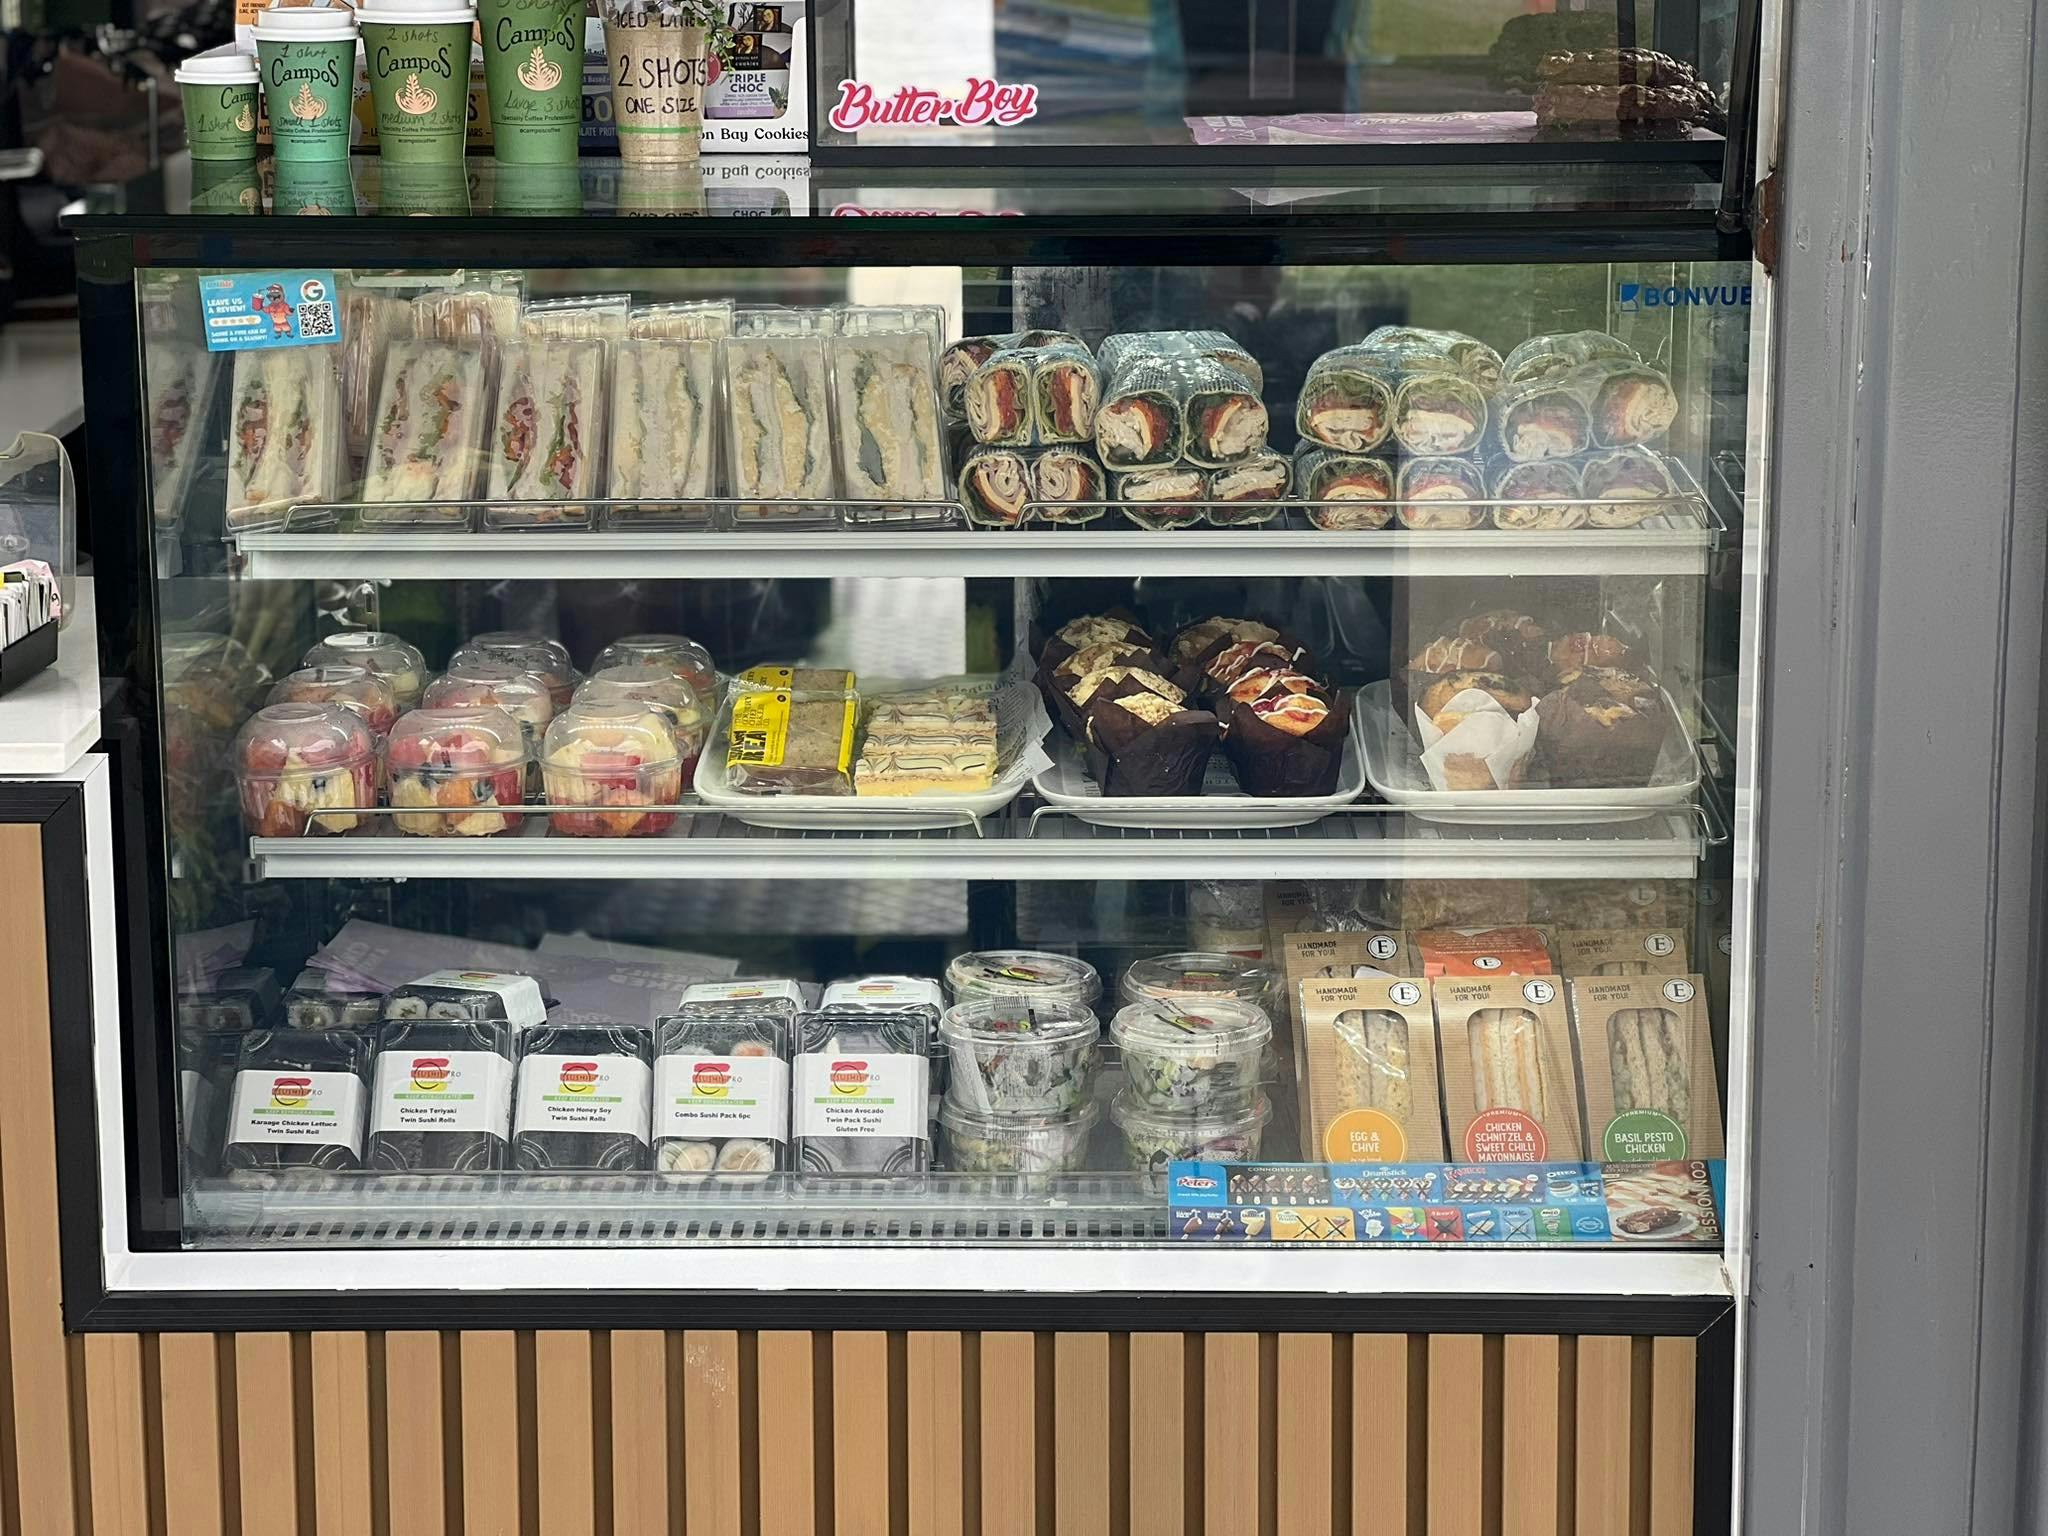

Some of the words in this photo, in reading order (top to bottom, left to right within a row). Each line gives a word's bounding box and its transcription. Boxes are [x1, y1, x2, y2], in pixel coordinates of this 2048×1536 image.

[617, 11, 648, 28] ICED
[387, 27, 398, 40] 2
[401, 28, 439, 43] shots
[280, 44, 290, 58] 1
[618, 54, 634, 87] 2
[639, 57, 706, 88] SHOTS
[729, 73, 766, 83] TRIPLE
[730, 83, 764, 92] CHOC
[505, 90, 537, 116] Large
[626, 97, 655, 113] ONE
[662, 97, 697, 113] SIZE
[833, 81, 952, 129] Butter
[954, 78, 1035, 123] Boy
[198, 114, 206, 132] 1
[721, 128, 748, 142] Bay
[755, 128, 809, 139] Cookies
[1644, 287, 1752, 306] BONVUE
[1297, 941, 1337, 950] HANDMADE
[1377, 940, 1389, 954] E
[1655, 938, 1666, 951] E
[1316, 986, 1357, 995] HANDMADE
[1400, 987, 1412, 1000] E
[1450, 984, 1492, 994] HANDMADE
[1535, 985, 1547, 999] E
[1588, 984, 1631, 993] HANDMADE
[1674, 984, 1686, 997] E
[1455, 994, 1470, 1002] FOR
[1472, 993, 1490, 1001] YOU!
[1594, 993, 1608, 1001] FOR
[1610, 992, 1629, 1000] YOU!
[1486, 1123, 1522, 1132] CHICKEN
[1350, 1132, 1367, 1141] EGG
[1371, 1132, 1380, 1141] &
[1475, 1133, 1523, 1142] SCHNITZEL
[1525, 1133, 1533, 1141] &
[1615, 1133, 1642, 1143] BASIL
[1644, 1132, 1674, 1142] PESTO
[1352, 1143, 1380, 1152] CHIVE
[1476, 1143, 1505, 1152] SWEET
[1509, 1142, 1535, 1151] CHILLI
[1625, 1144, 1665, 1153] CHICKEN
[1478, 1152, 1535, 1162] MAYONNAISE
[1363, 1168, 1407, 1177] Drumstick
